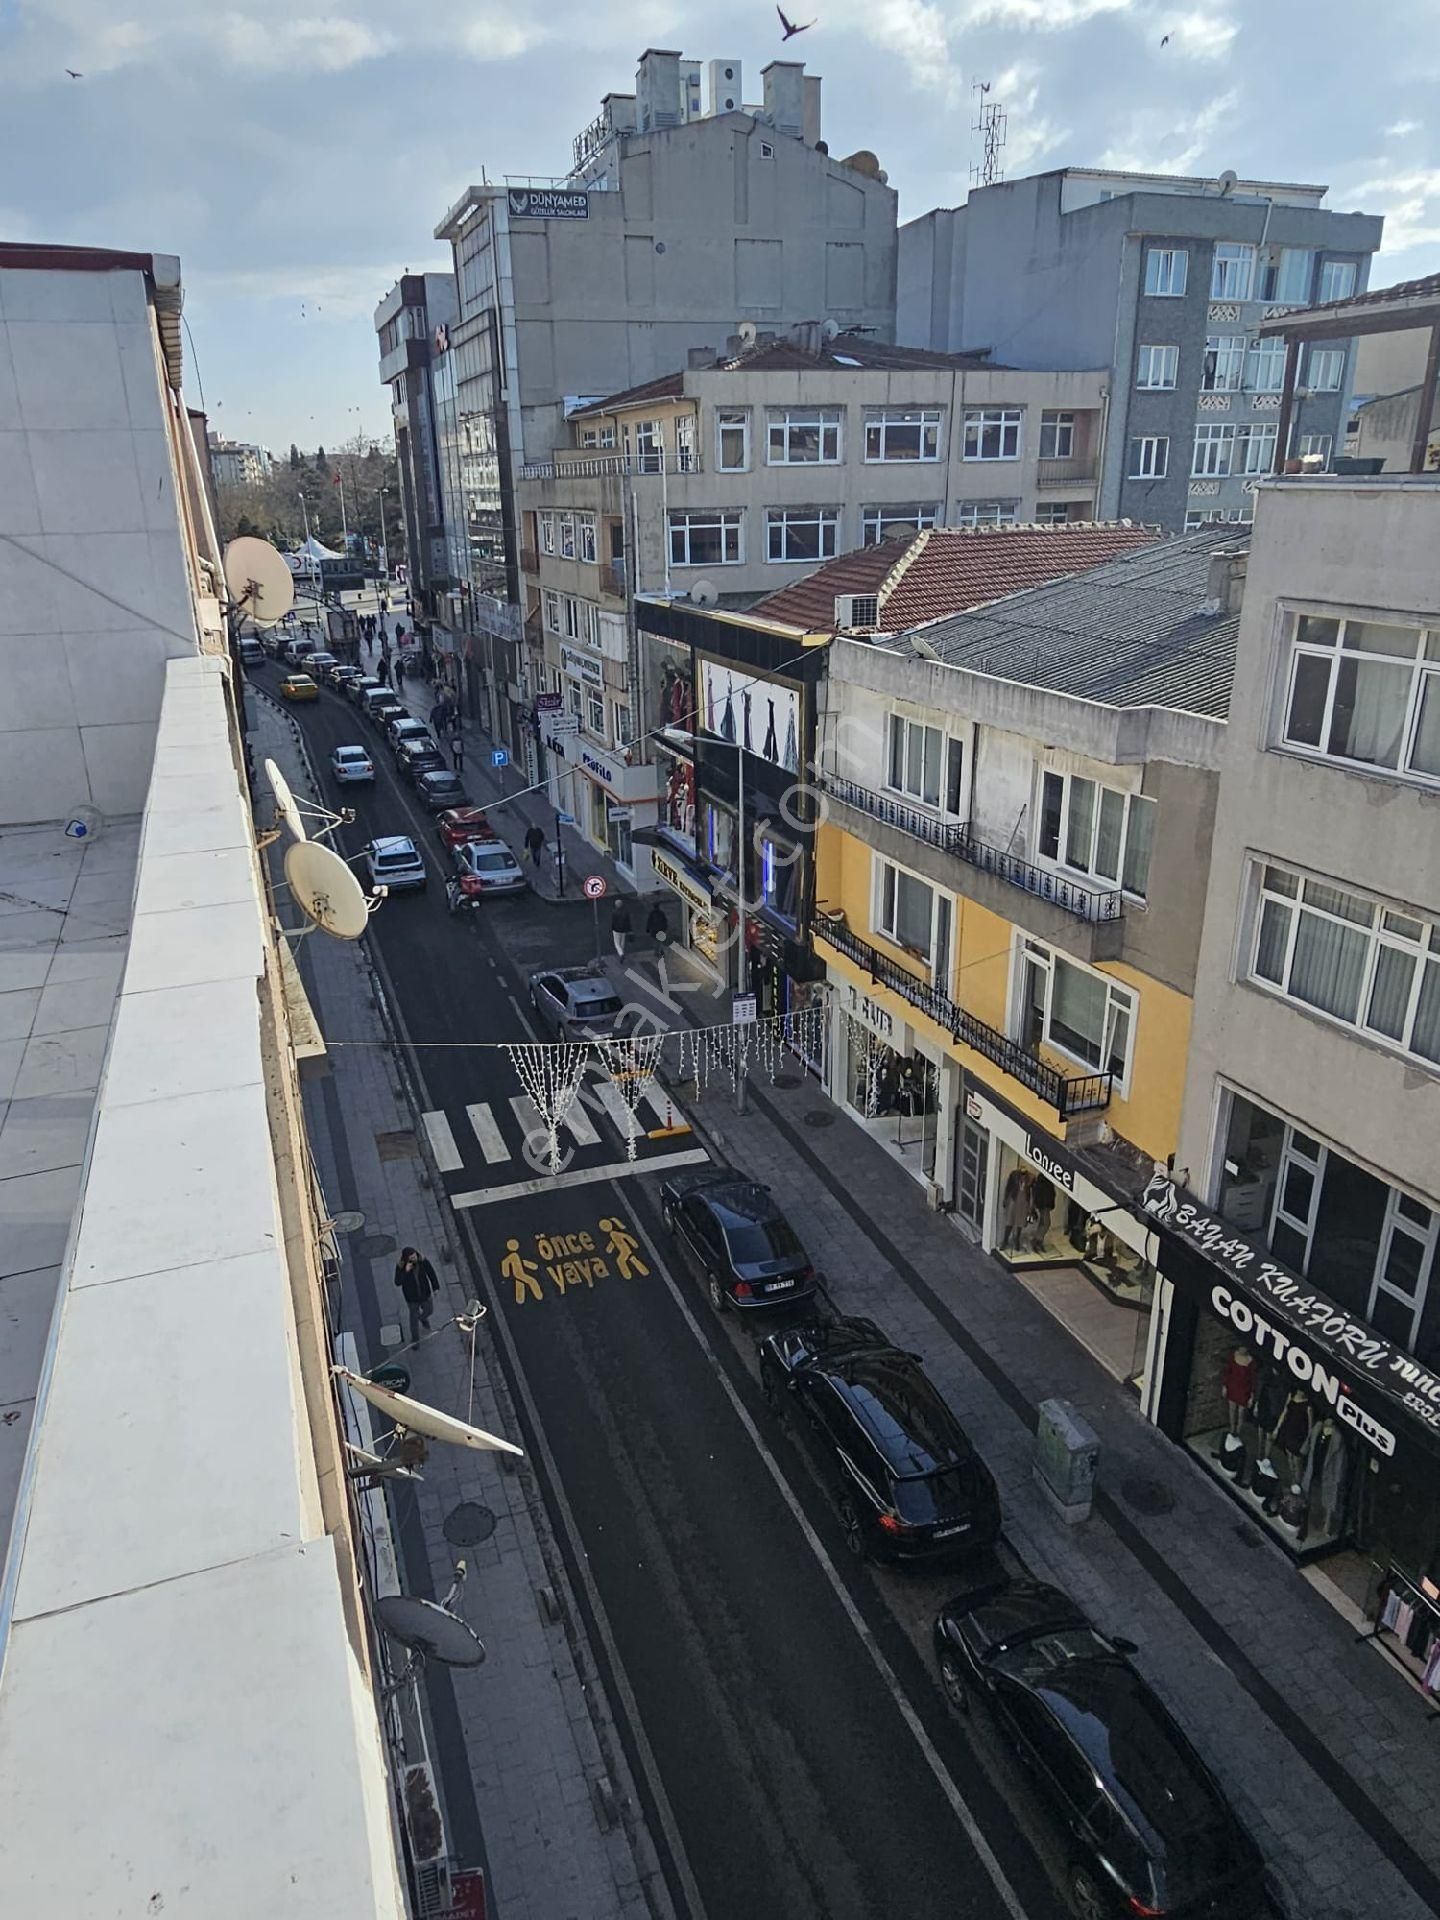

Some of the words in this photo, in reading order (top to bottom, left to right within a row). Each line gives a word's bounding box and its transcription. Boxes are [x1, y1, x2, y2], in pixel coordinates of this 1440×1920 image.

[530, 191, 586, 207] DÜNYAMED
[494, 753, 504, 764] P
[535, 1230, 596, 1261] önce
[546, 1257, 610, 1295] yaya
[1176, 1204, 1256, 1269] BAYAN
[1256, 1262, 1390, 1369] KUAFÖRÜ
[1211, 1285, 1340, 1405] COTTON
